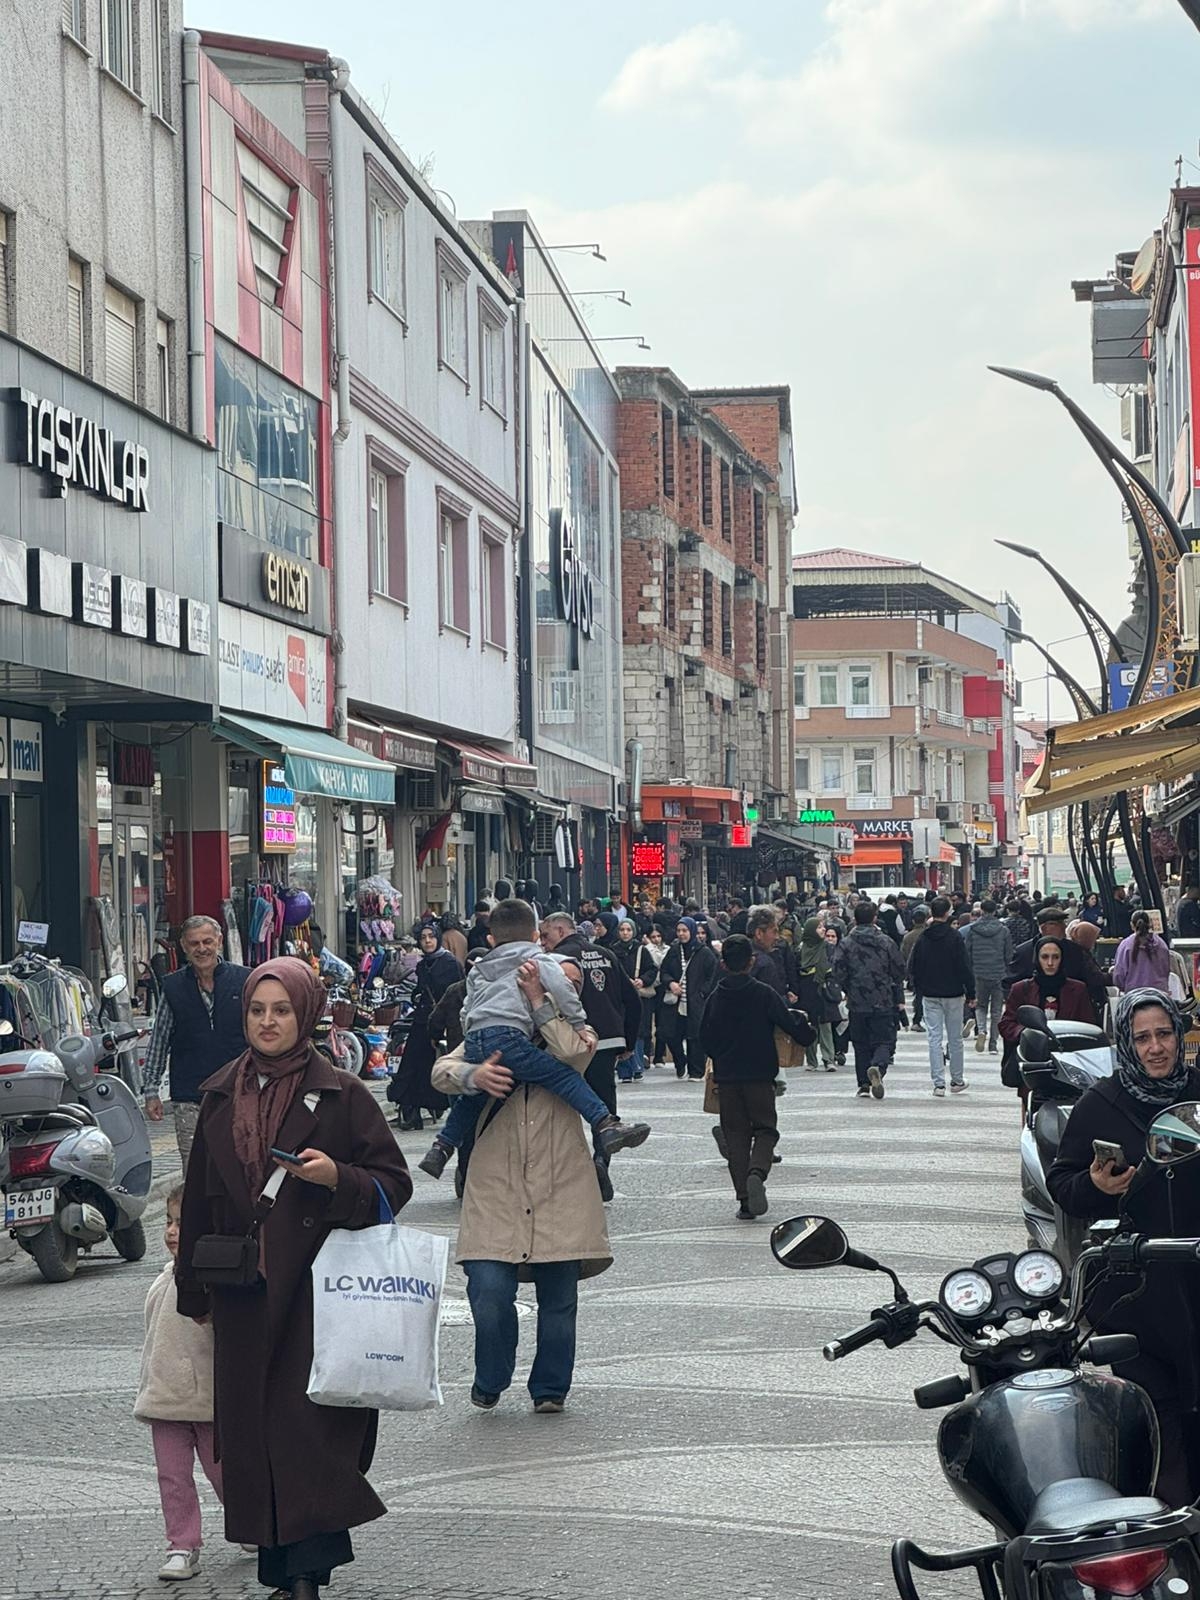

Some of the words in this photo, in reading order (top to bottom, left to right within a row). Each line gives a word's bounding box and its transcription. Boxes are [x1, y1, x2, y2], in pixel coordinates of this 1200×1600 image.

[20, 387, 150, 512] TAŞKINLAR
[267, 552, 311, 614] emsan
[13, 732, 40, 772] mavi
[800, 810, 835, 822] AYNA
[581, 950, 603, 960] ÖZEL
[18, 1205, 42, 1218] 811
[324, 1275, 354, 1293] LC
